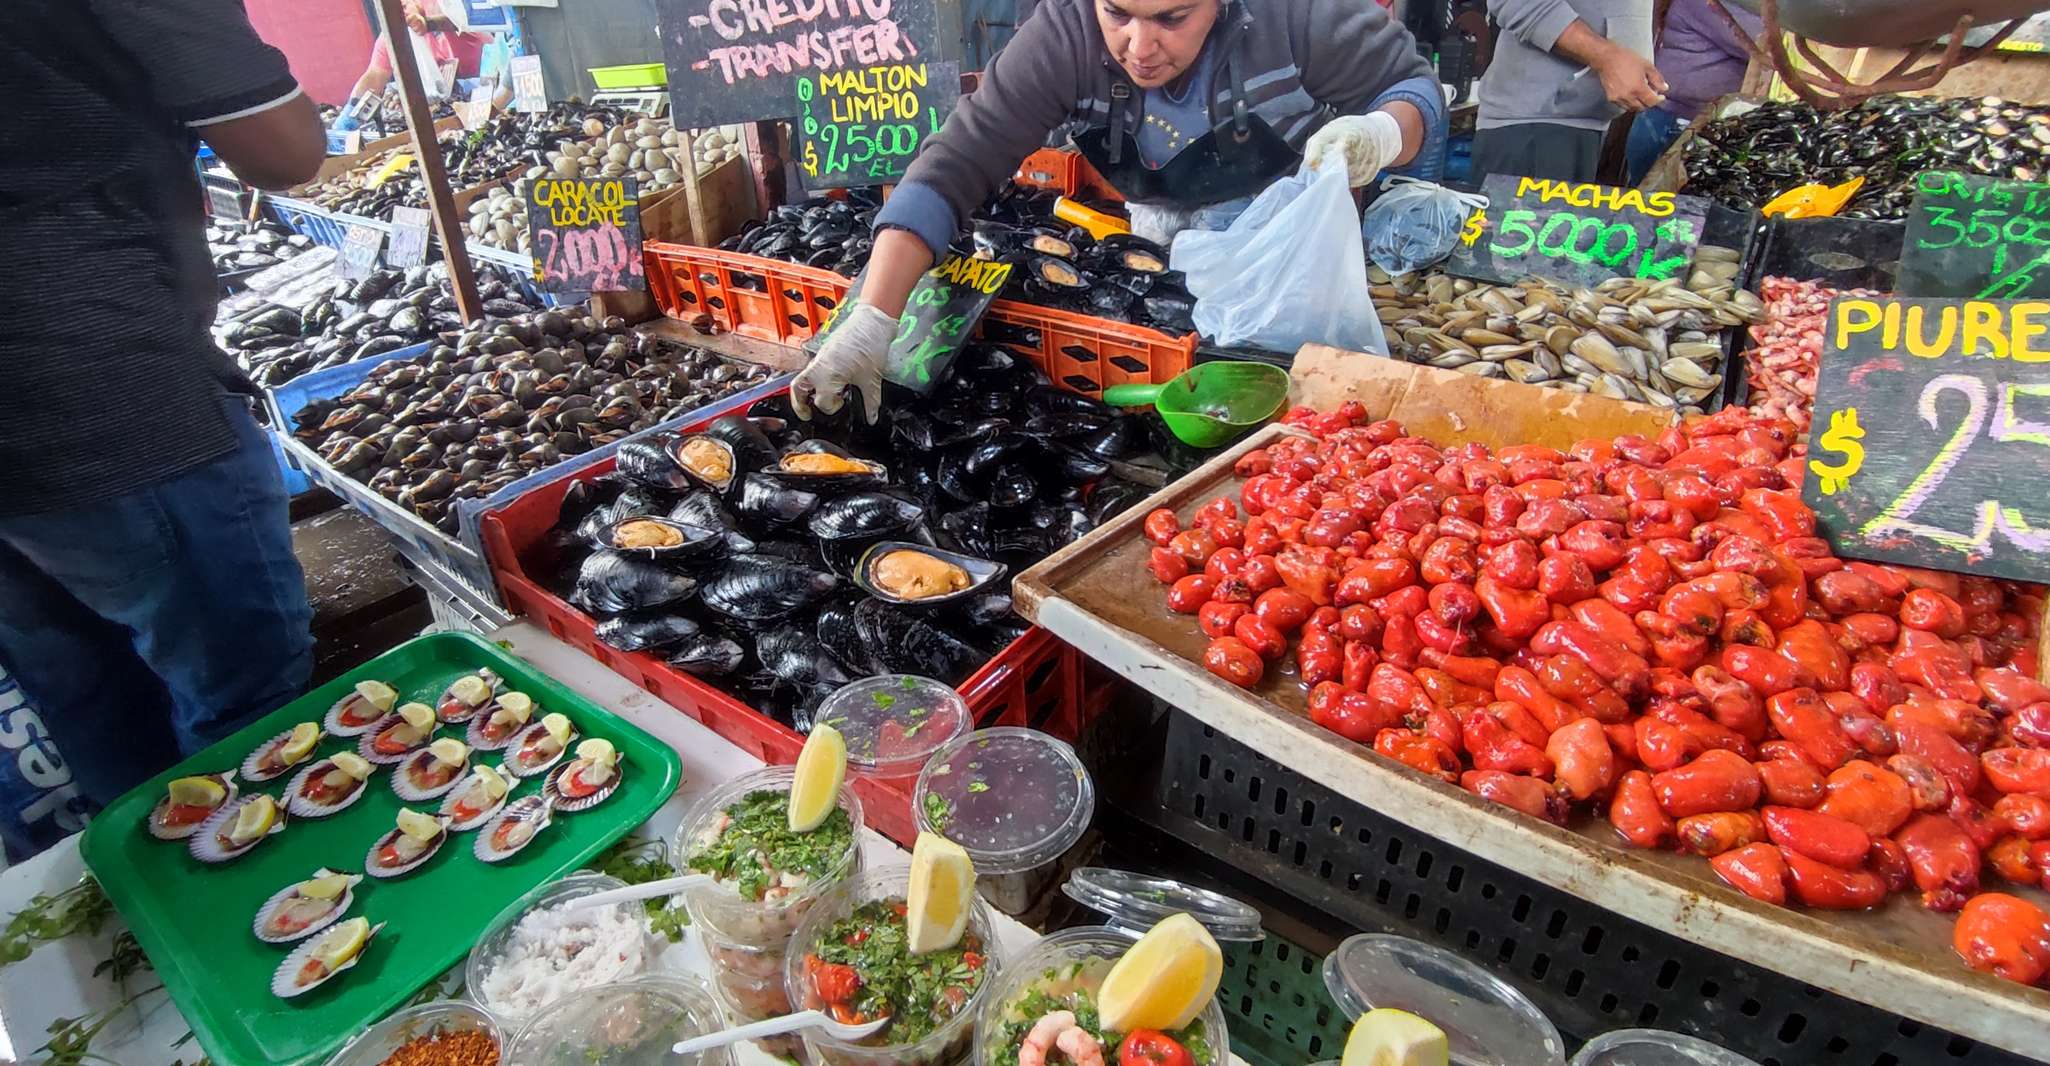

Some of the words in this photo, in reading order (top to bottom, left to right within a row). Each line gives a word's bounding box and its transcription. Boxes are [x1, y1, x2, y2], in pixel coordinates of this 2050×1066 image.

[819, 63, 928, 96] MALTON
[831, 91, 920, 123] LIMPIO
[803, 140, 819, 178] $
[820, 124, 919, 175] 2500
[533, 180, 638, 208] CARACOL
[1516, 176, 1677, 218] MACHAS
[1918, 171, 2050, 215] CRIST
[550, 204, 627, 227] LOCATE
[1460, 208, 1488, 249] $
[1489, 210, 1638, 268] 5000
[1836, 301, 2050, 363] PIURE
[1809, 407, 1867, 496] $
